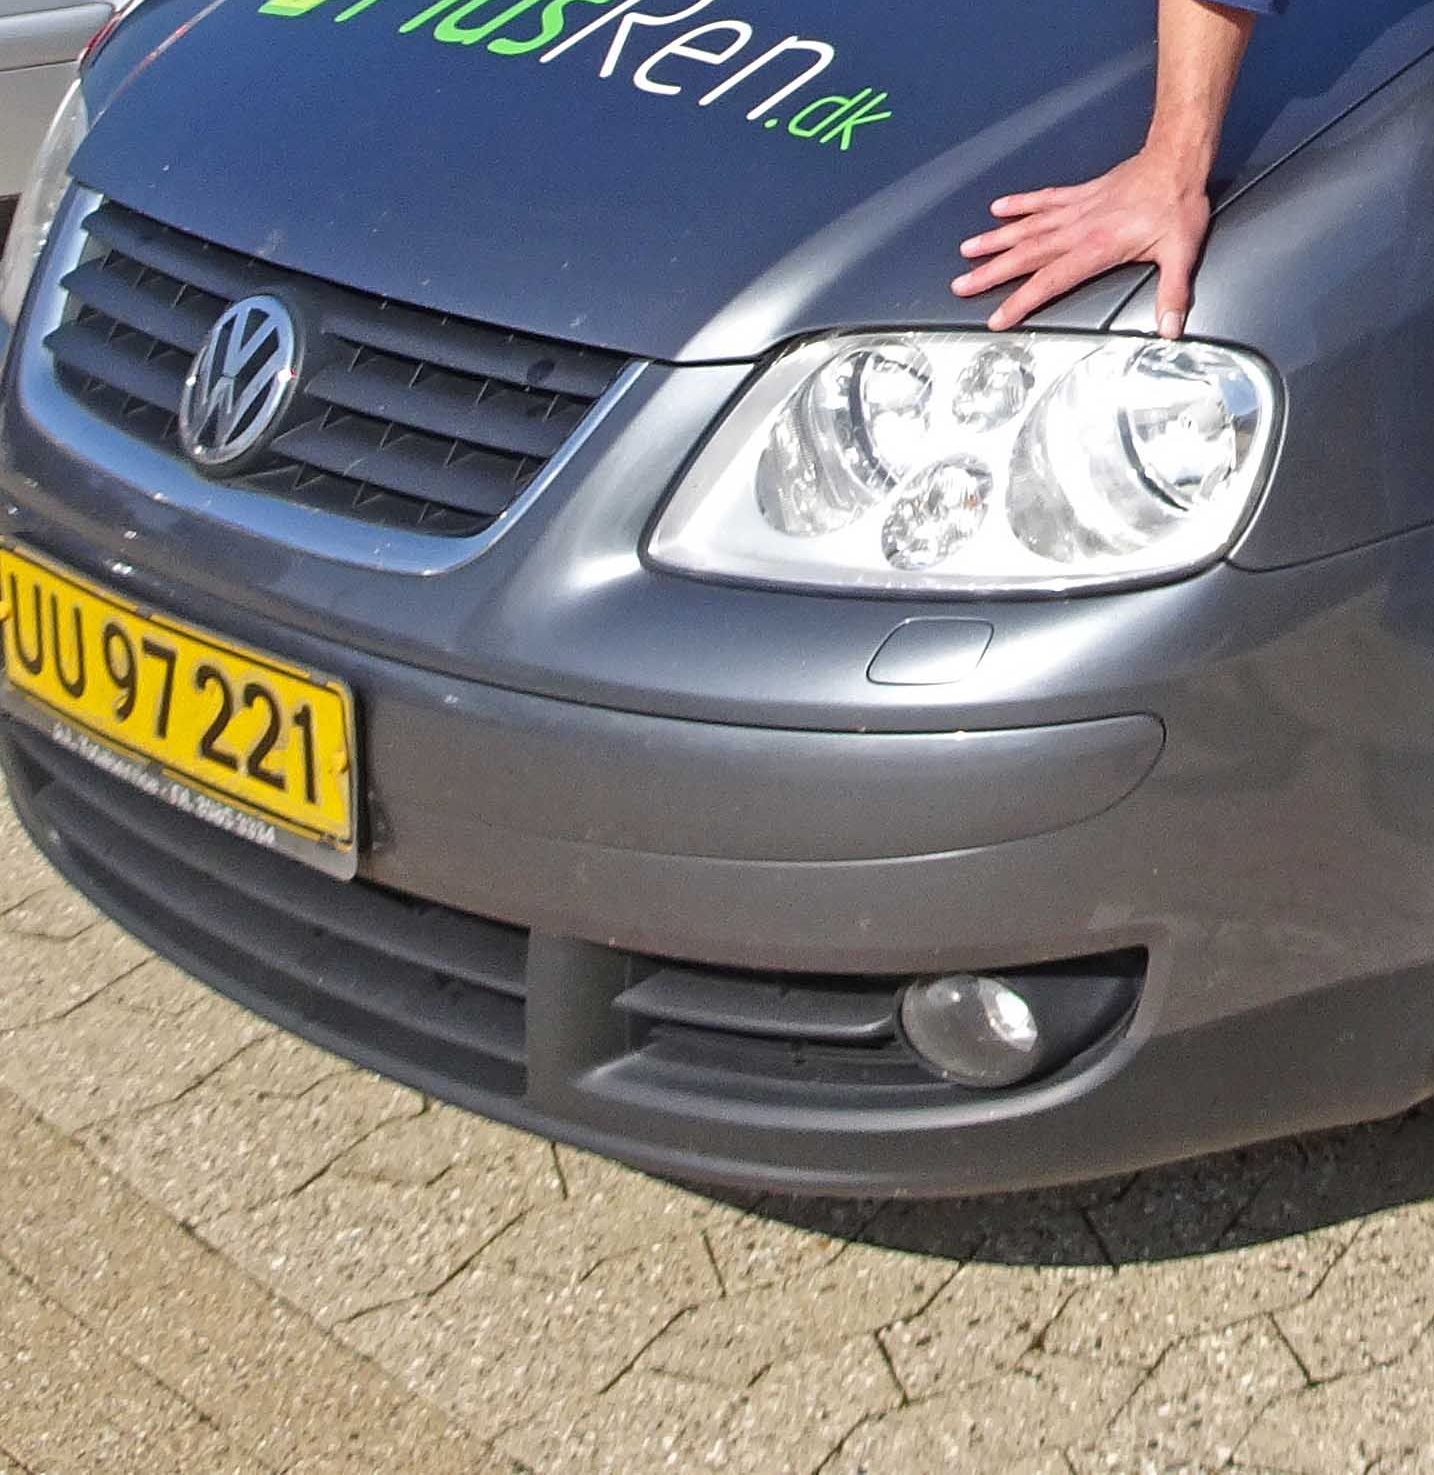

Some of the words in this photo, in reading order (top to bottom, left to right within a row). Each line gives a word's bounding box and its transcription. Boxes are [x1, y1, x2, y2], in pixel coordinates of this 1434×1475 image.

[10, 572, 86, 699] UU
[103, 621, 177, 740] 97
[196, 665, 318, 805] 221
